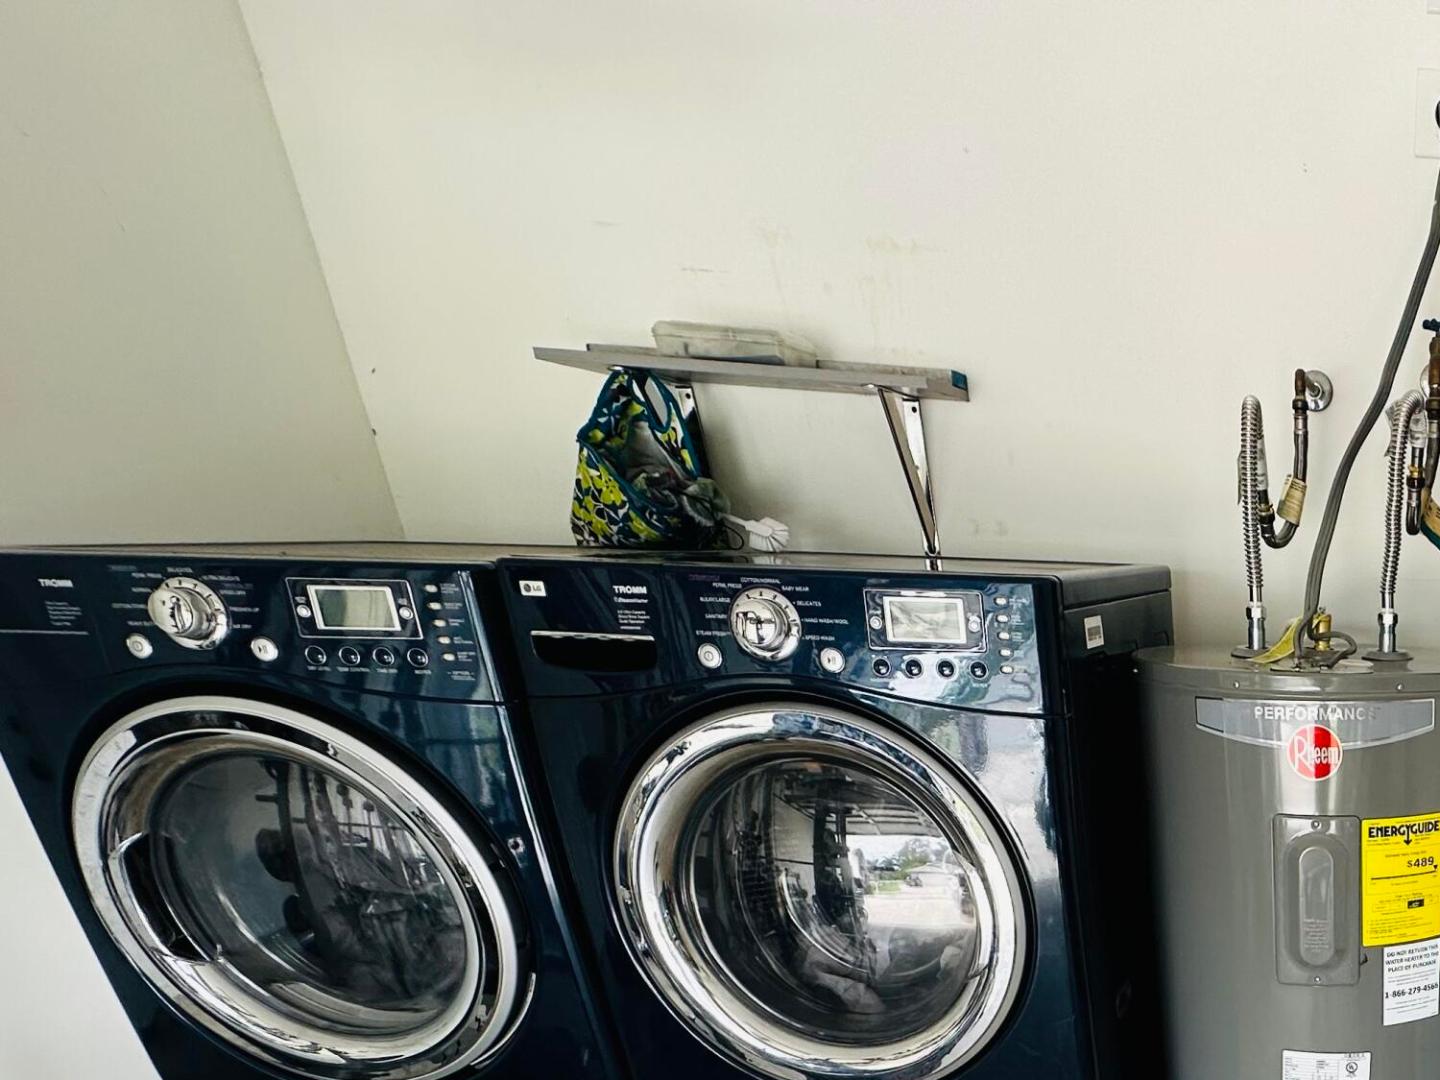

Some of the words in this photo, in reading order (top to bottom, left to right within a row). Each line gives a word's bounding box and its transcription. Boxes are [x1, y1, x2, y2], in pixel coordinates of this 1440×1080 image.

[613, 585, 647, 594] TROMM
[1254, 705, 1377, 721] PERFORMANCE
[1293, 734, 1339, 772] Rheem
[1407, 856, 1434, 868] $489
[1386, 958, 1404, 966] WATER
[1404, 955, 1423, 963] HEATER
